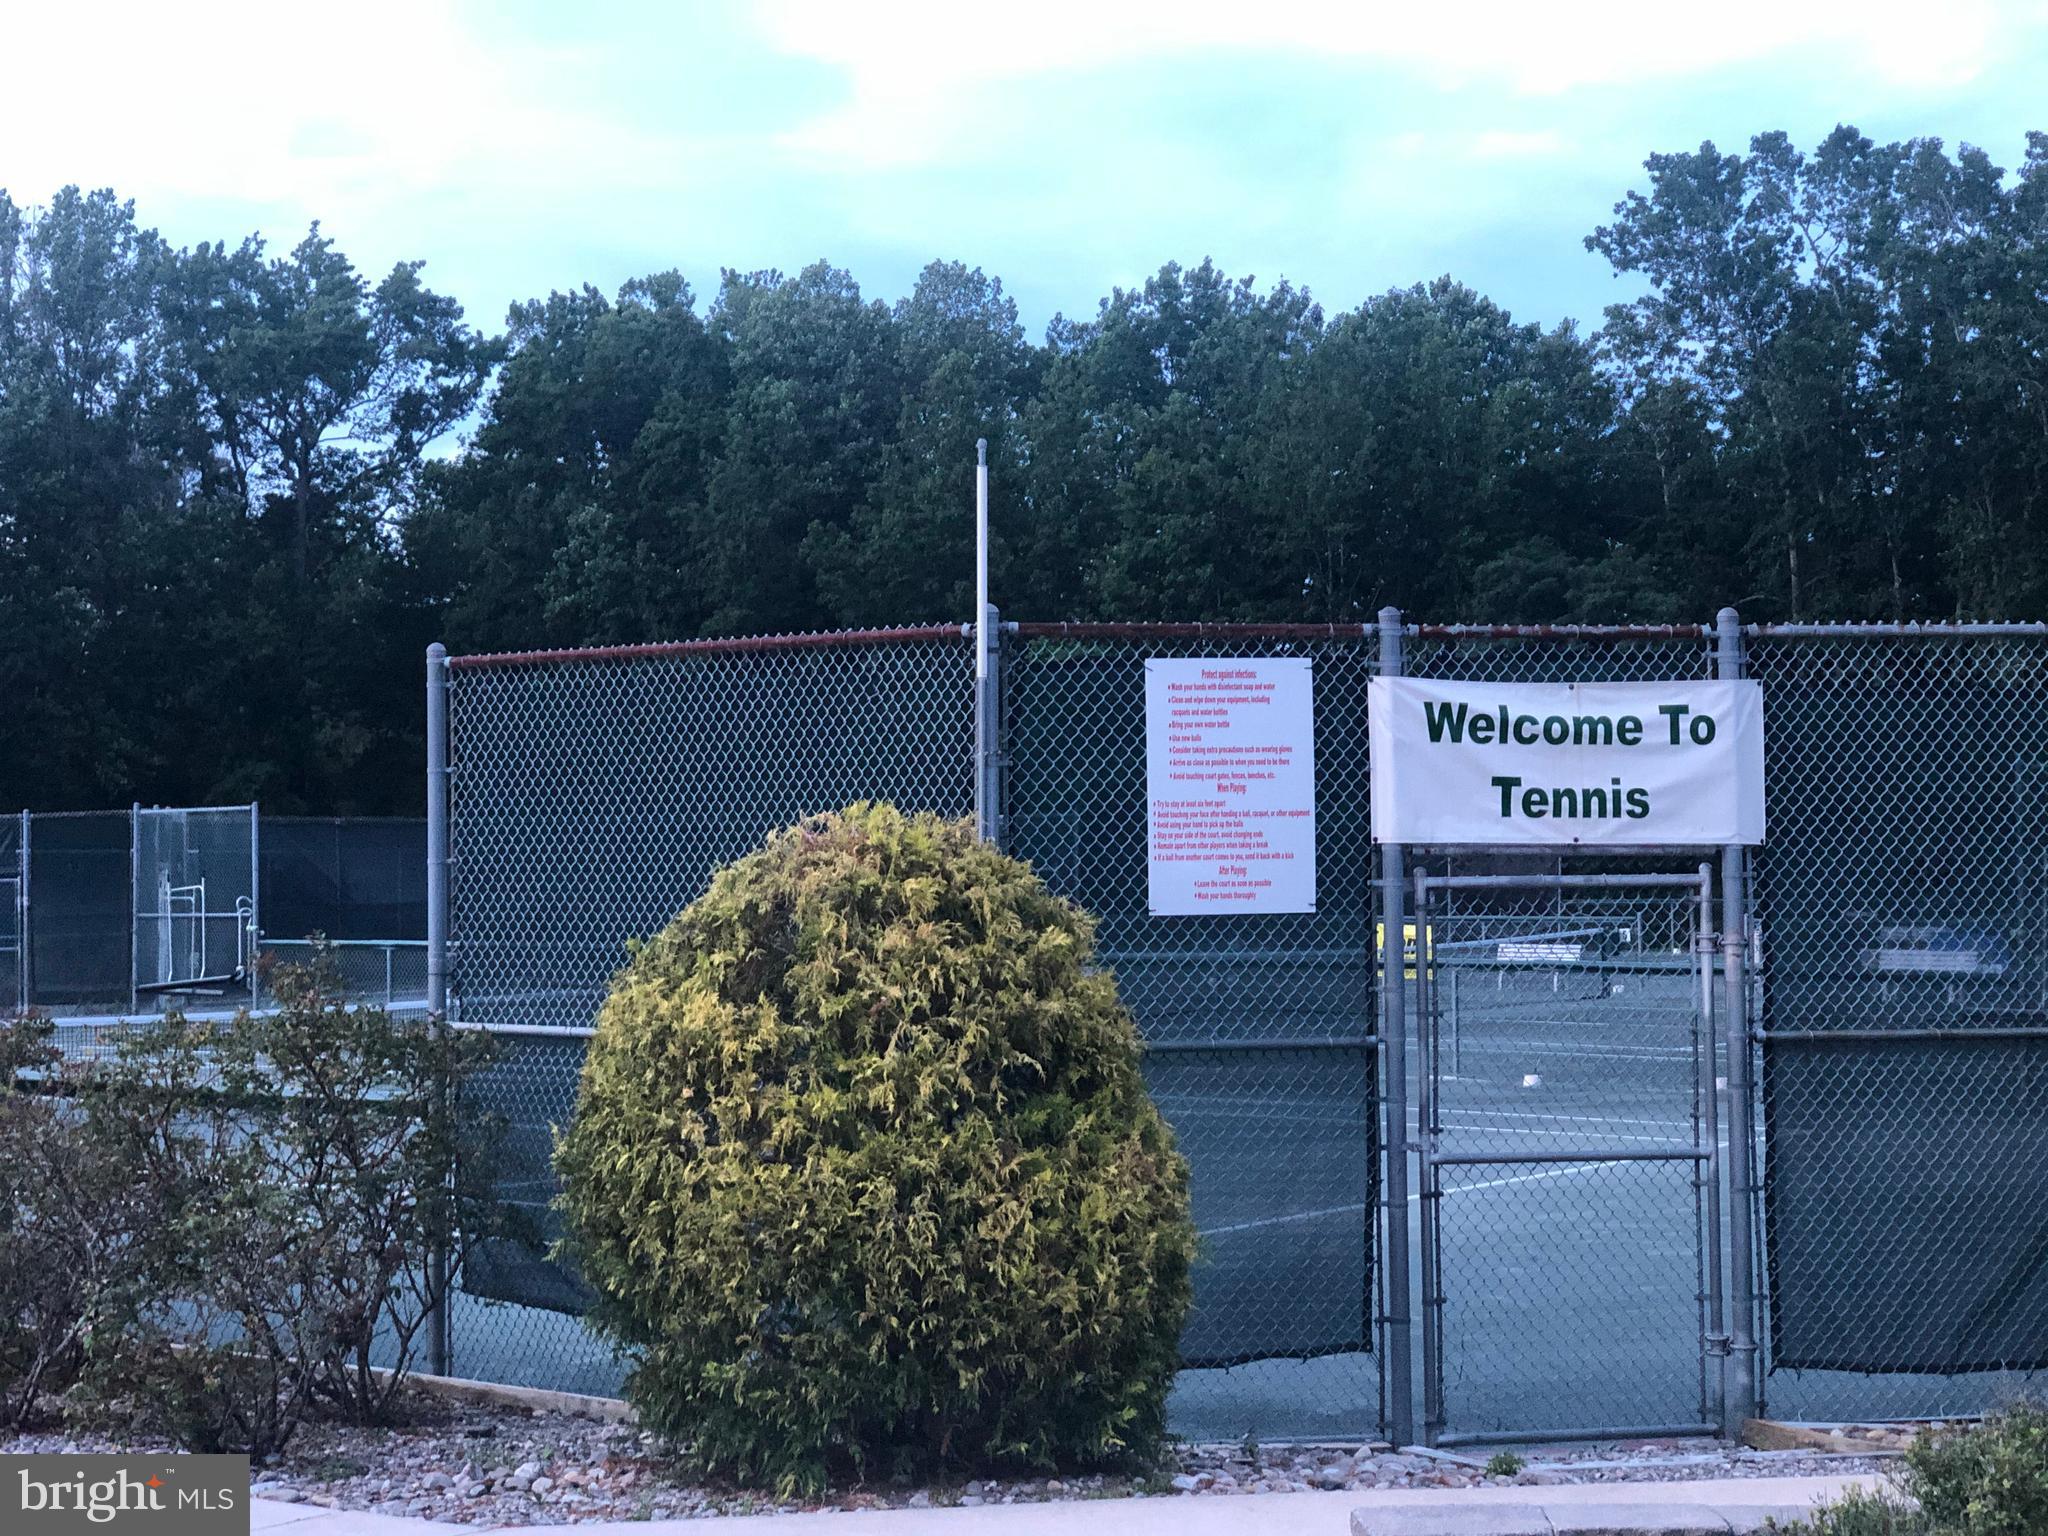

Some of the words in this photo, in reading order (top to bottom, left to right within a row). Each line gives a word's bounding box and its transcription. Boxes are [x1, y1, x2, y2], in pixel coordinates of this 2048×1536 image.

[1201, 670, 1217, 679] Protect
[1218, 670, 1234, 681] against
[1194, 696, 1203, 705] wipe
[1172, 721, 1183, 730] Bring
[1423, 701, 1643, 746] Welcome
[1658, 703, 1717, 746] To
[1192, 746, 1205, 755] taking
[1211, 758, 1228, 768] possible
[1186, 772, 1204, 781] touching
[1217, 784, 1229, 792] When
[1491, 775, 1651, 819] Tennis
[1171, 800, 1179, 809] stay
